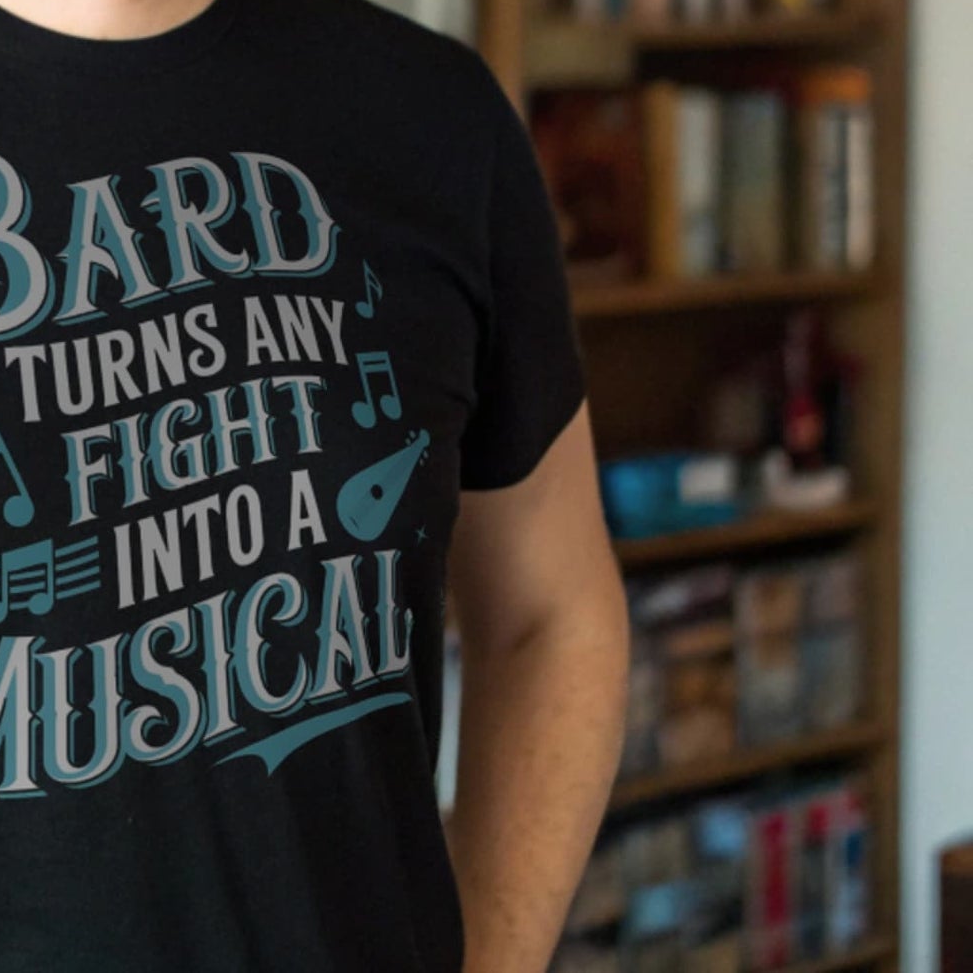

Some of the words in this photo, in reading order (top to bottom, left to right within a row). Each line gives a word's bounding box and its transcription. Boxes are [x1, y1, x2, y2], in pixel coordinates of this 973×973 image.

[4, 310, 228, 423] TURNS
[246, 294, 350, 368] ANY
[63, 374, 327, 527] FIGHT
[114, 484, 265, 610] INTO
[287, 470, 327, 550] A
